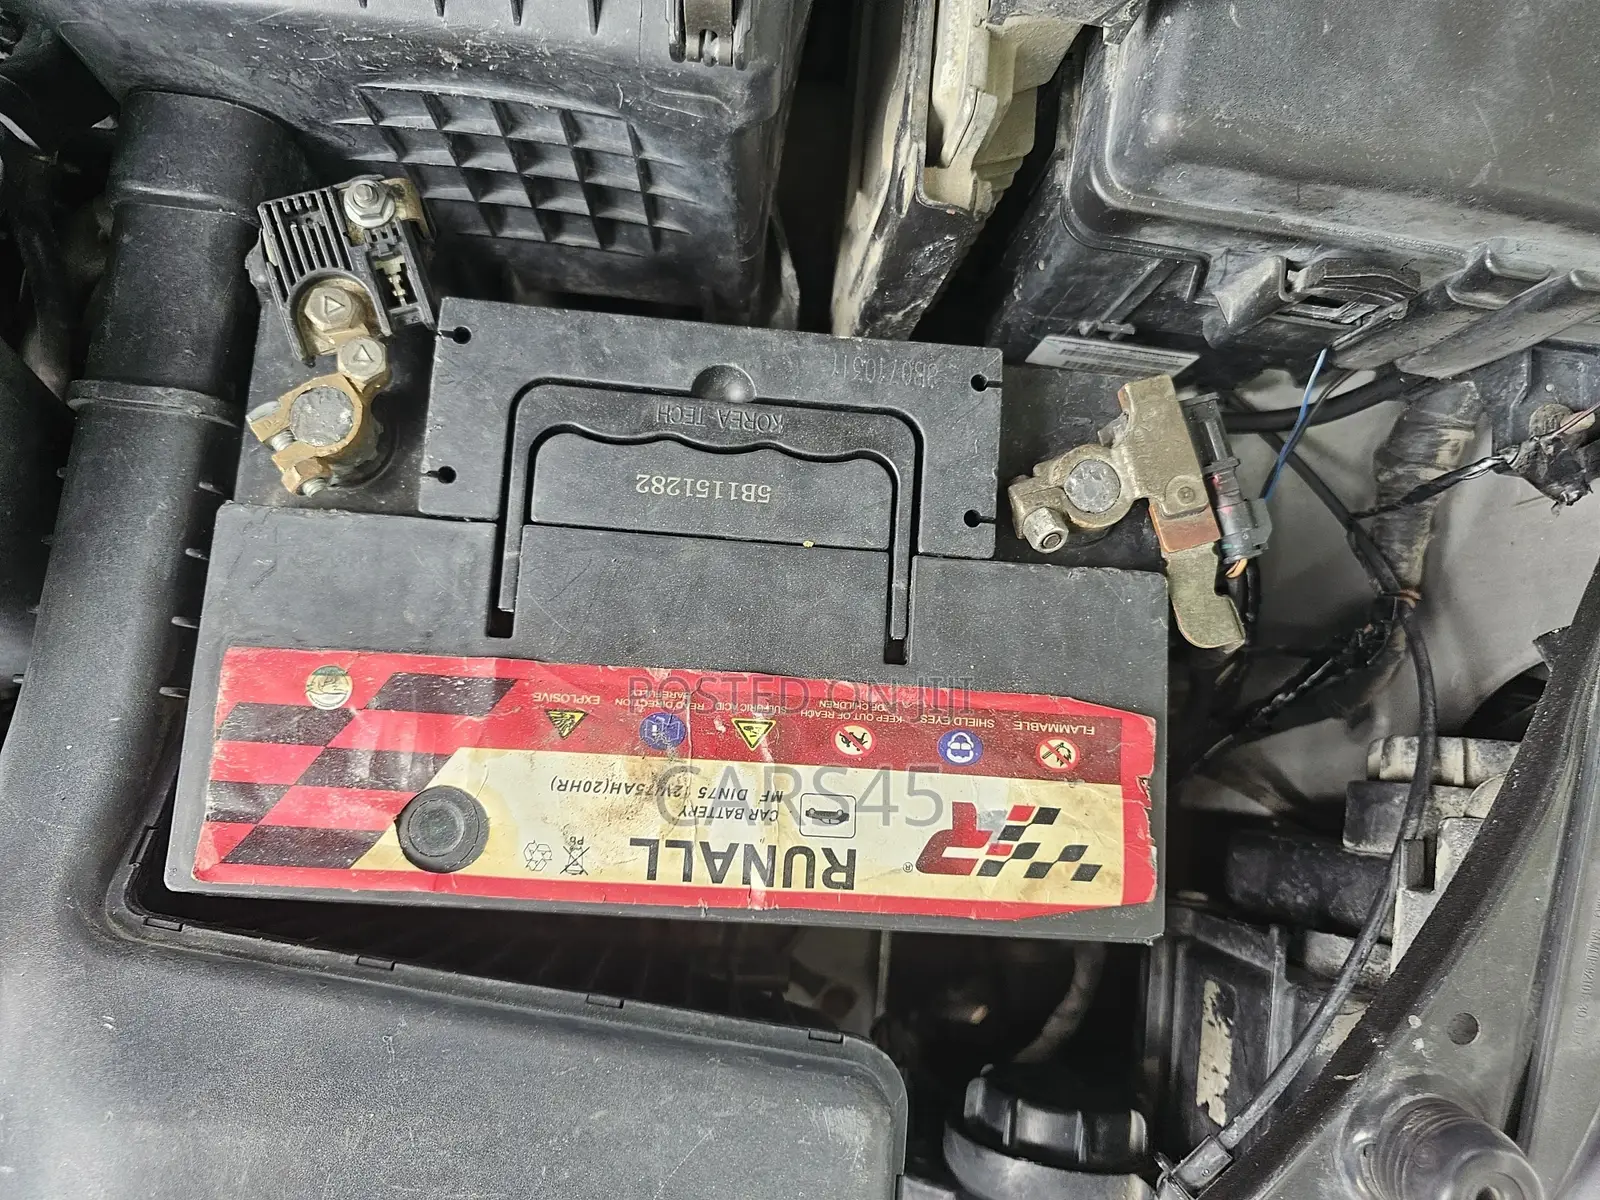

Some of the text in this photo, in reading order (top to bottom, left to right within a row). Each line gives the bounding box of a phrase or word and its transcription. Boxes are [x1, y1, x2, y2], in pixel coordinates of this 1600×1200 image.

[656, 404, 783, 433] KOREA TECH
[635, 474, 772, 503] 5B1151282
[532, 692, 600, 705] EXPLOSIVE
[819, 700, 868, 711] CHILDREN
[715, 702, 787, 714] SULFURIC ACID
[801, 709, 902, 723] KEEP OUT OF REACH
[920, 714, 995, 729] SHIELD EYES
[1014, 720, 1095, 735] FLAMMABLE
[698, 786, 748, 801] DIN75
[759, 790, 783, 803] MF
[678, 805, 779, 822] CAR BATTERY
[629, 838, 857, 890] RUNALL
